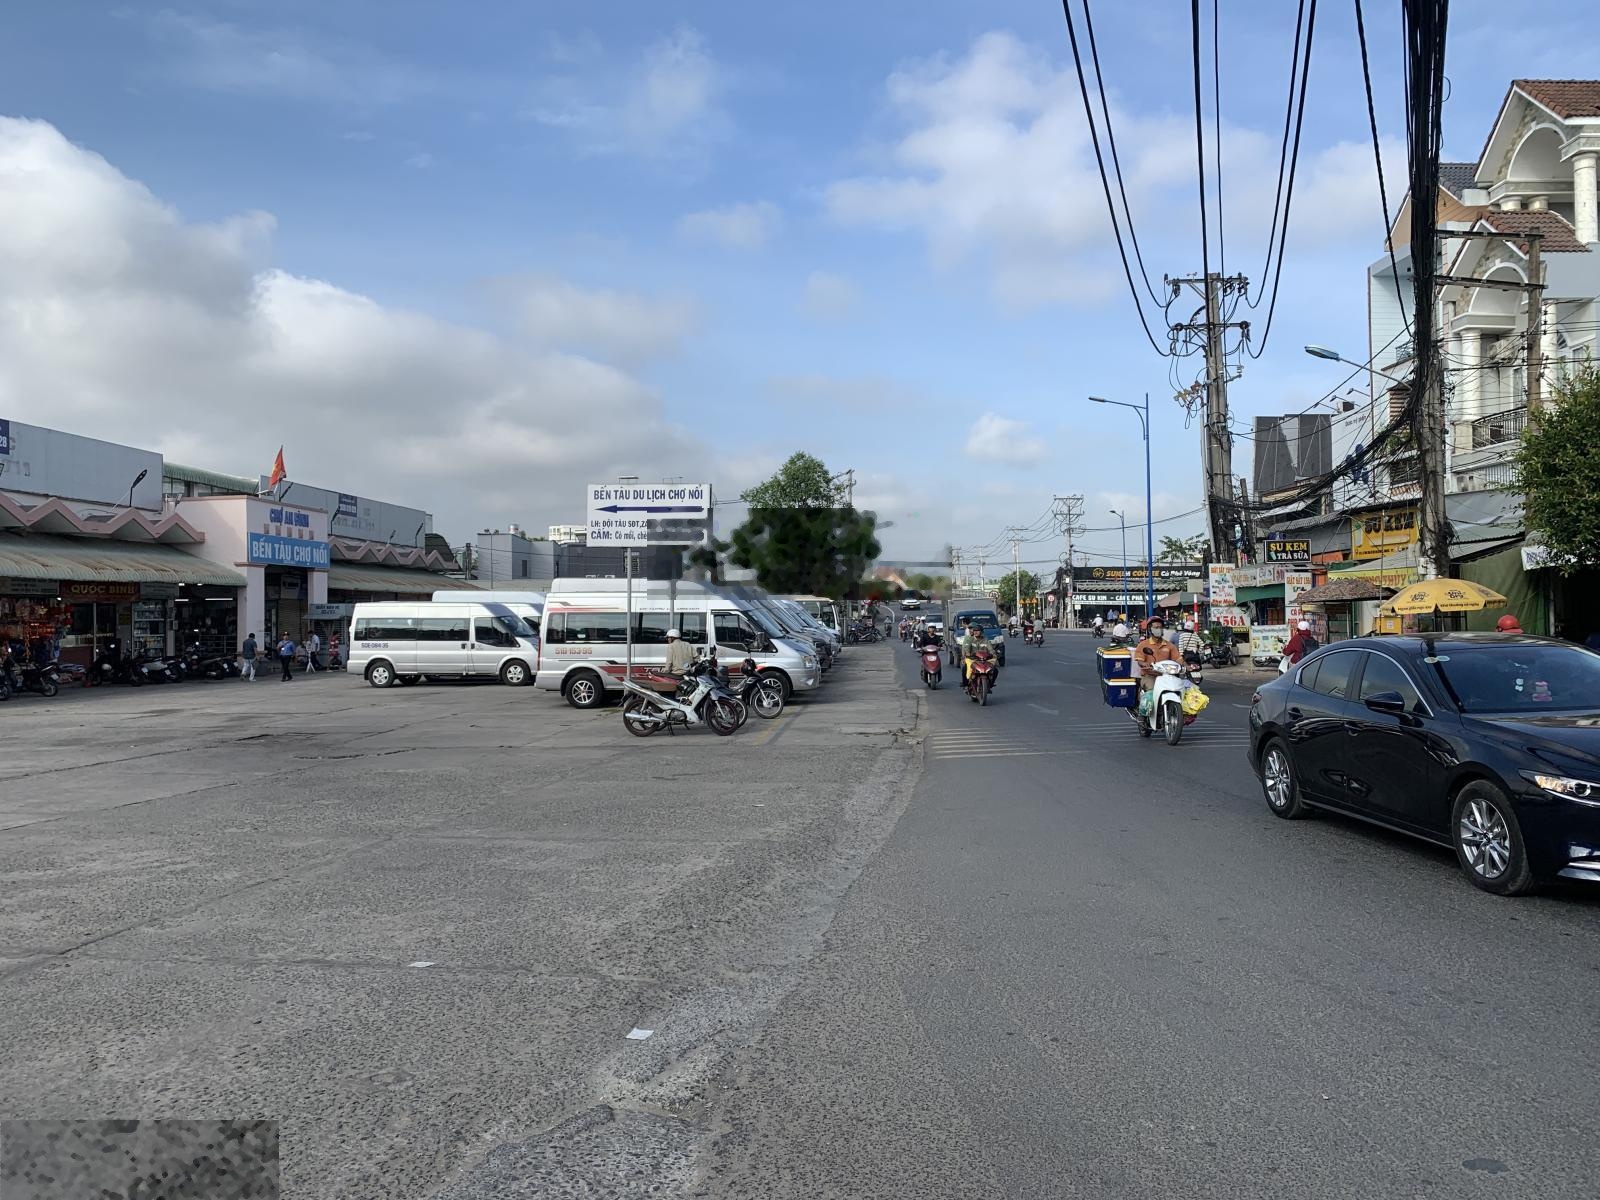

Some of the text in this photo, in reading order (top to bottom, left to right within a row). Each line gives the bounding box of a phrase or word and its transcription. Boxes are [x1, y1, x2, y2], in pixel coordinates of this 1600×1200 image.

[594, 484, 703, 502] BẾN TÀU DU LỊCH CHỢ NỔI
[591, 520, 601, 528] LH:
[602, 518, 613, 529] ĐỘI
[614, 518, 626, 528] TÀU
[591, 528, 612, 540] CẤM:
[252, 536, 272, 559] BẾN
[274, 541, 291, 560] TÀU
[294, 545, 311, 566] CHỢ
[1270, 542, 1307, 551] SU KEM
[1276, 551, 1308, 560] TRÀ SỮA
